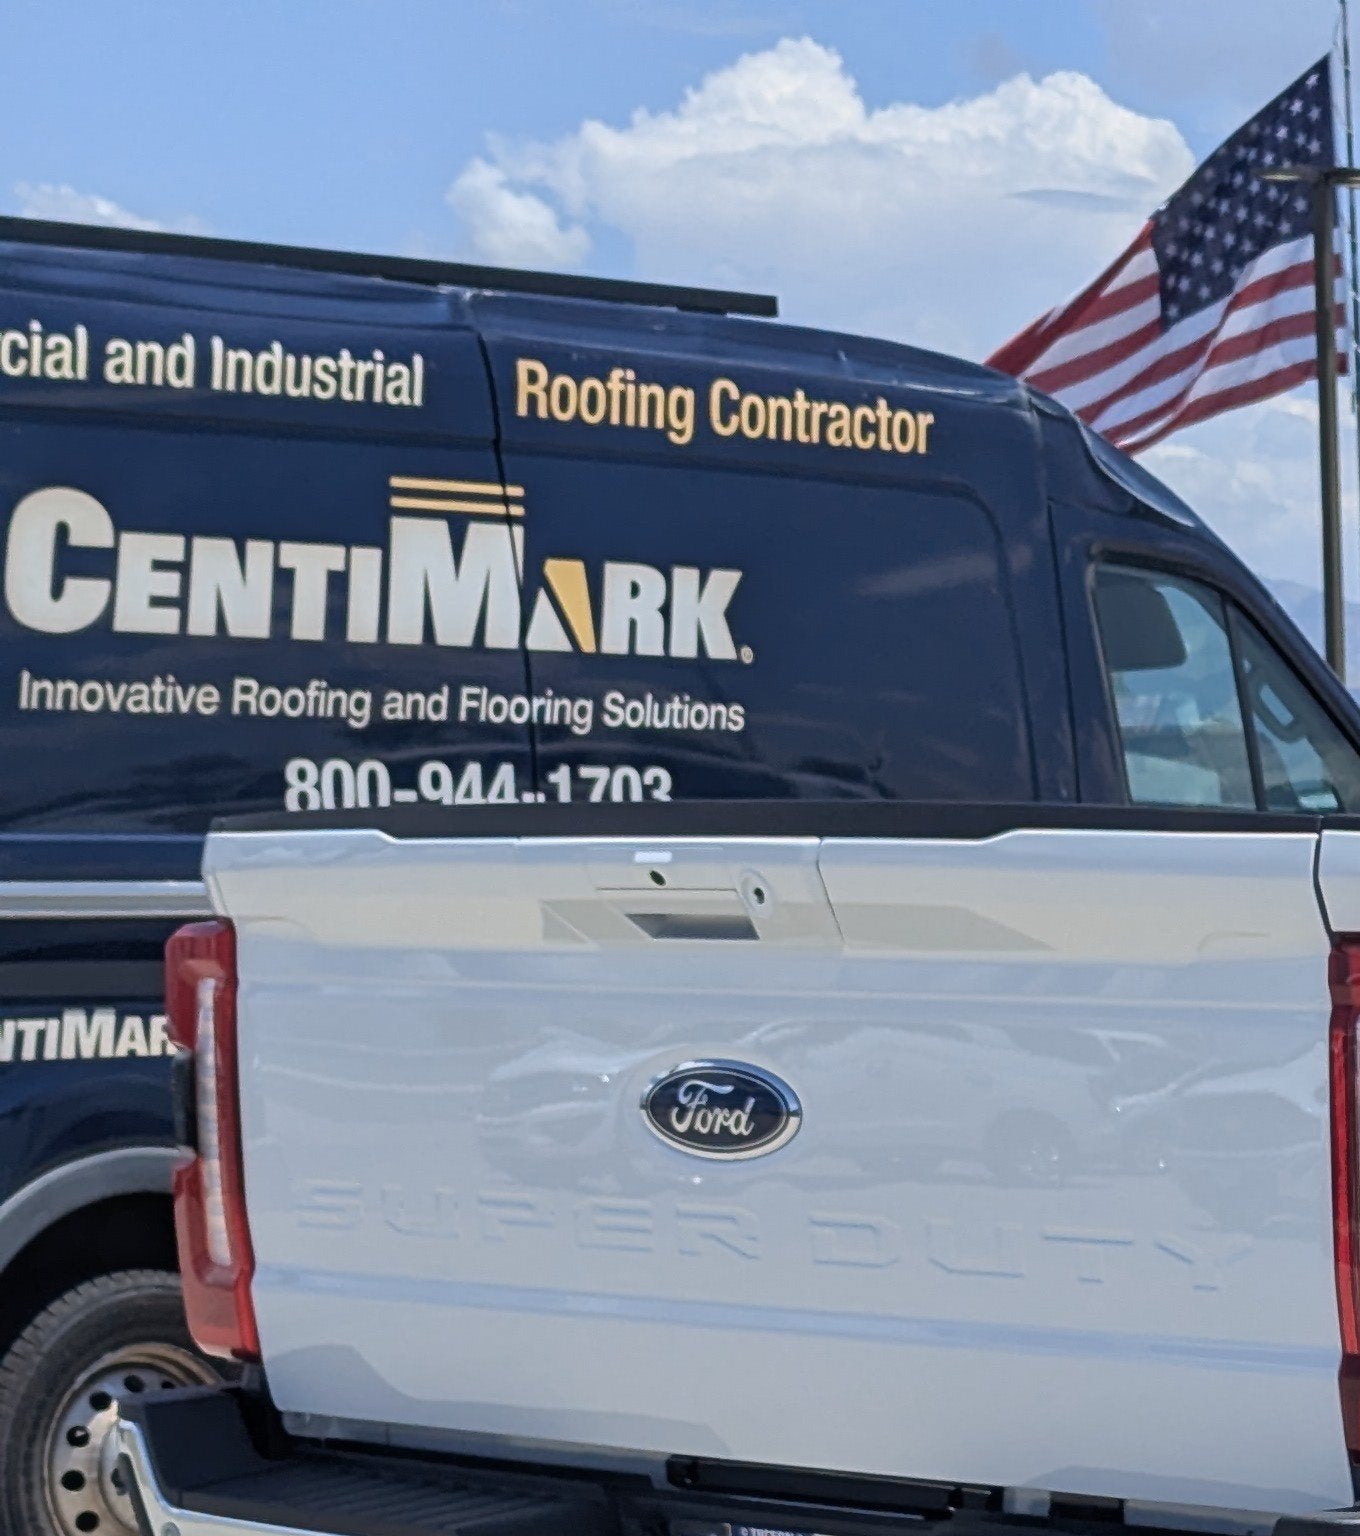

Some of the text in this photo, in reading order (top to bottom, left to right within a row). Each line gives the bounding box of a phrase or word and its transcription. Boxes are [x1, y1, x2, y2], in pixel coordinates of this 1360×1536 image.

[104, 332, 196, 389] and
[210, 335, 423, 407] Industrial
[515, 357, 935, 455] Roofing Contractor
[18, 669, 747, 736] Innovative Roofing and Flooring Solutions
[671, 1079, 756, 1137] Ford
[296, 1177, 1256, 1294] SUPER DUTY
